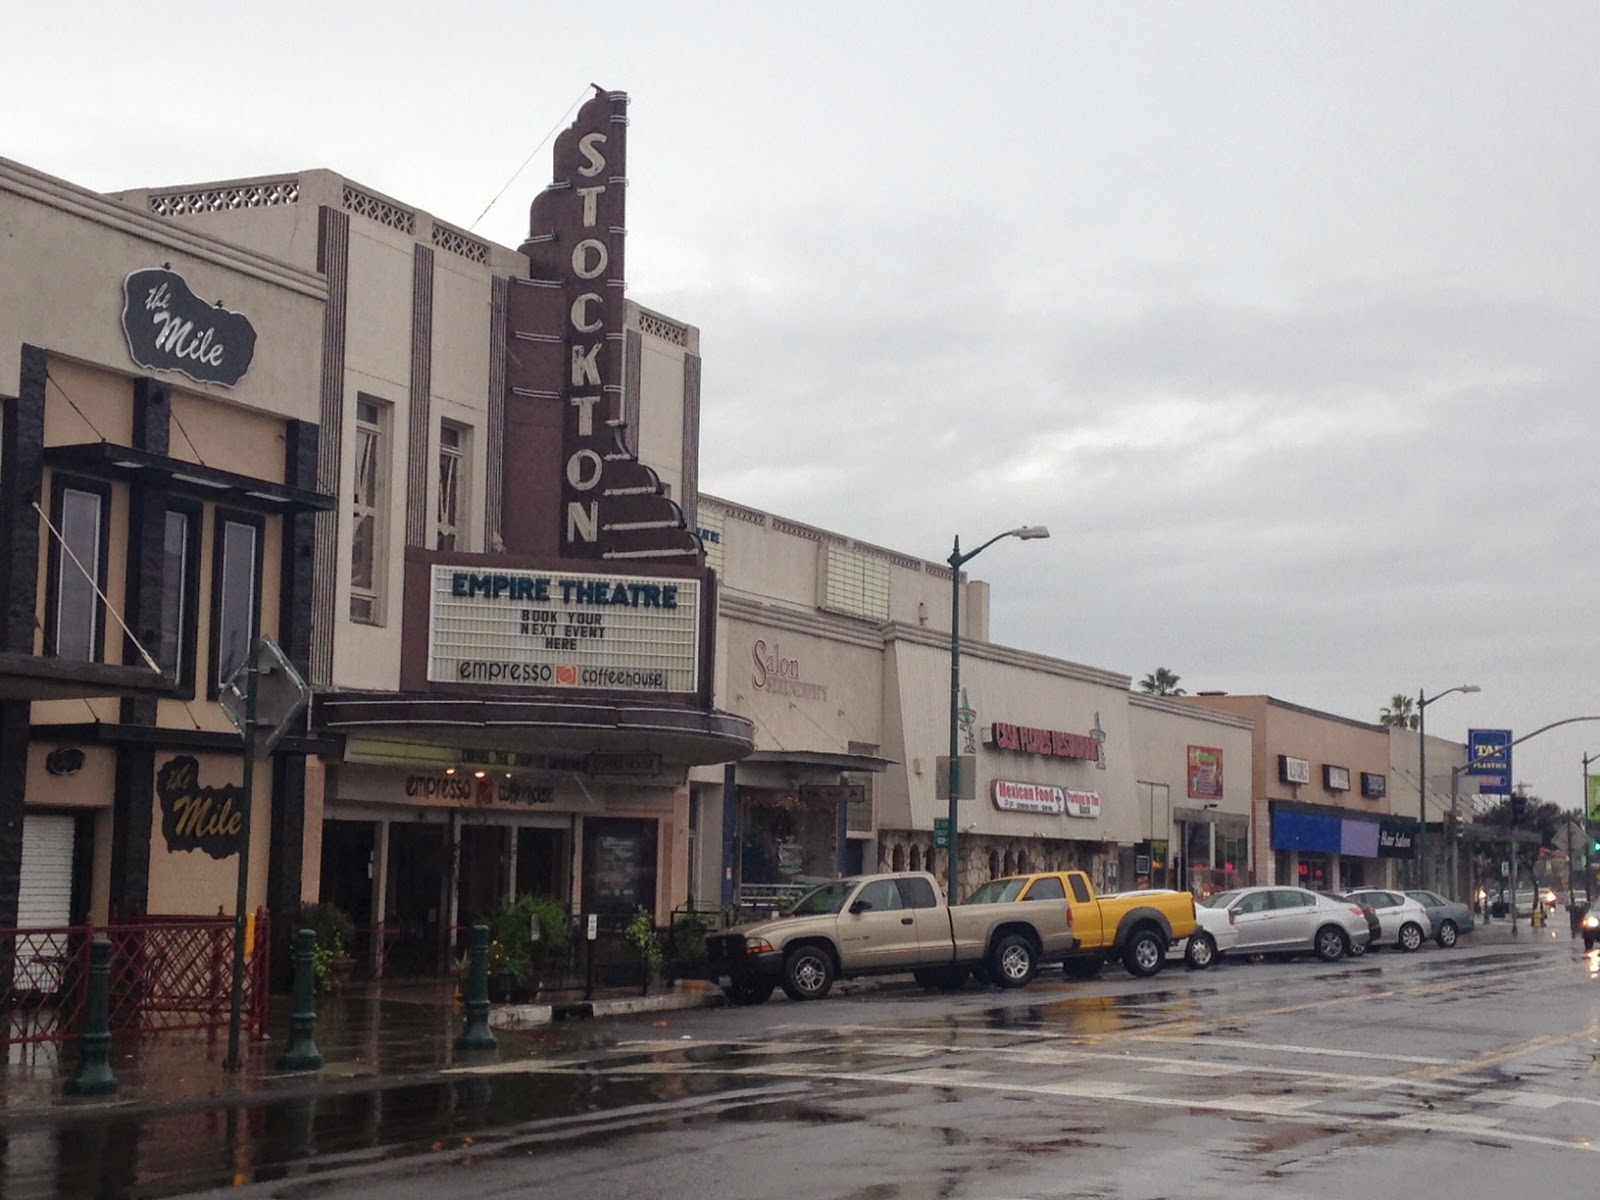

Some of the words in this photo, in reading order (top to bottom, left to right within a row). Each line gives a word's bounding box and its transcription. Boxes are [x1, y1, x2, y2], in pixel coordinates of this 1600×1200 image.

[144, 282, 172, 310] the
[153, 311, 225, 367] Mile
[566, 132, 608, 544] STOCKTON
[452, 572, 551, 602] EMPIRE
[559, 579, 678, 609] THEATRE
[521, 610, 558, 623] BOOK
[567, 612, 603, 626] YOUR
[521, 623, 557, 636] NEXT
[564, 625, 606, 639] EVENT
[545, 637, 577, 650] HERE
[460, 661, 552, 682] empresso
[582, 668, 663, 687] coffeehouse
[752, 639, 799, 689] Salon
[167, 763, 191, 790] the
[405, 774, 471, 800] empresso
[999, 782, 1034, 801] Mexican
[1035, 786, 1055, 803] Food
[173, 795, 242, 838] Mile
[1381, 830, 1395, 846] Hair
